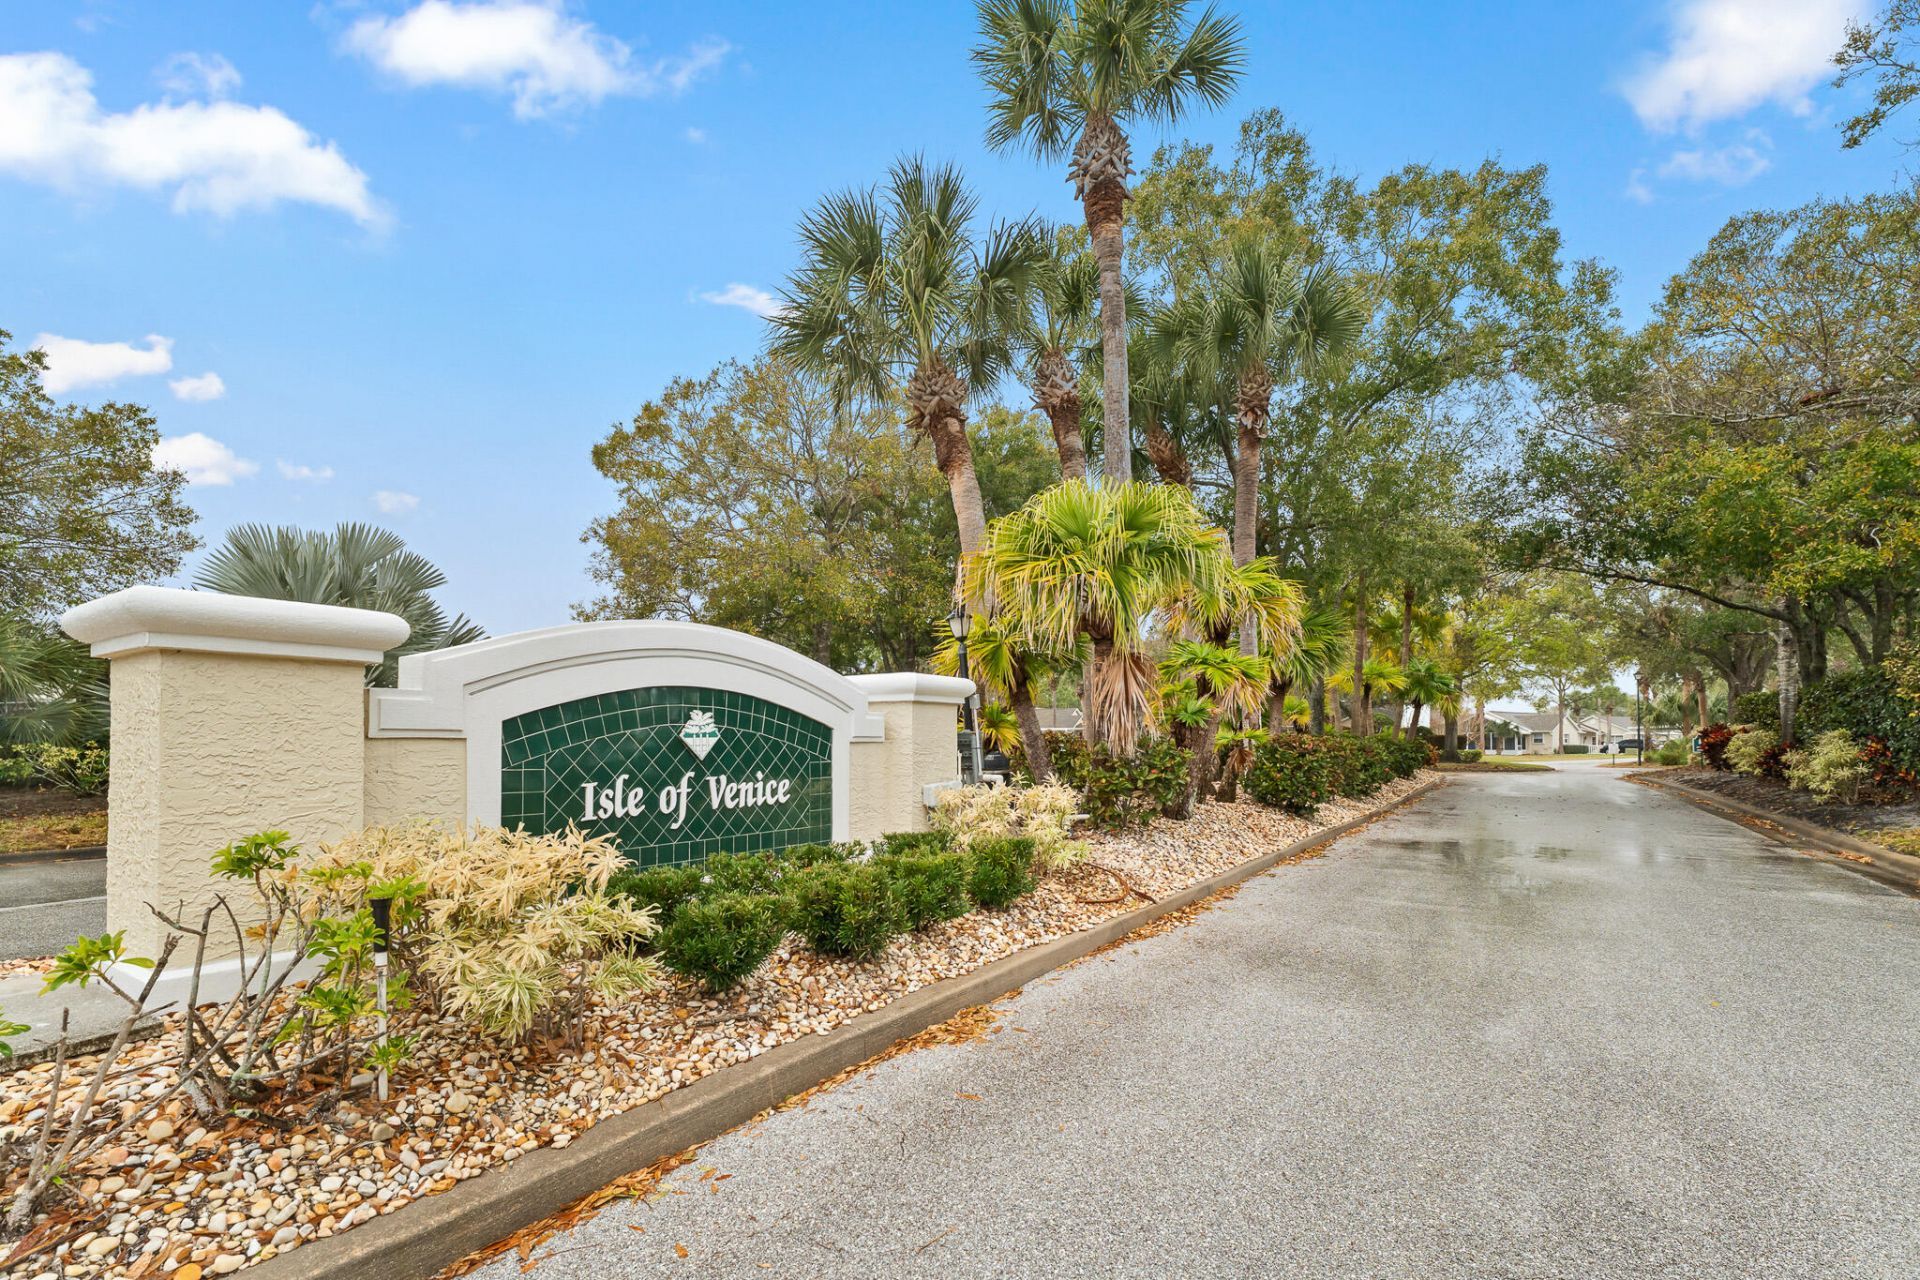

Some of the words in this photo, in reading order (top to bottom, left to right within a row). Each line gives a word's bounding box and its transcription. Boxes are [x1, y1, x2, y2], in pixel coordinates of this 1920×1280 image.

[581, 774, 645, 822] Isle
[659, 771, 695, 830] of
[705, 771, 791, 810] Venice
